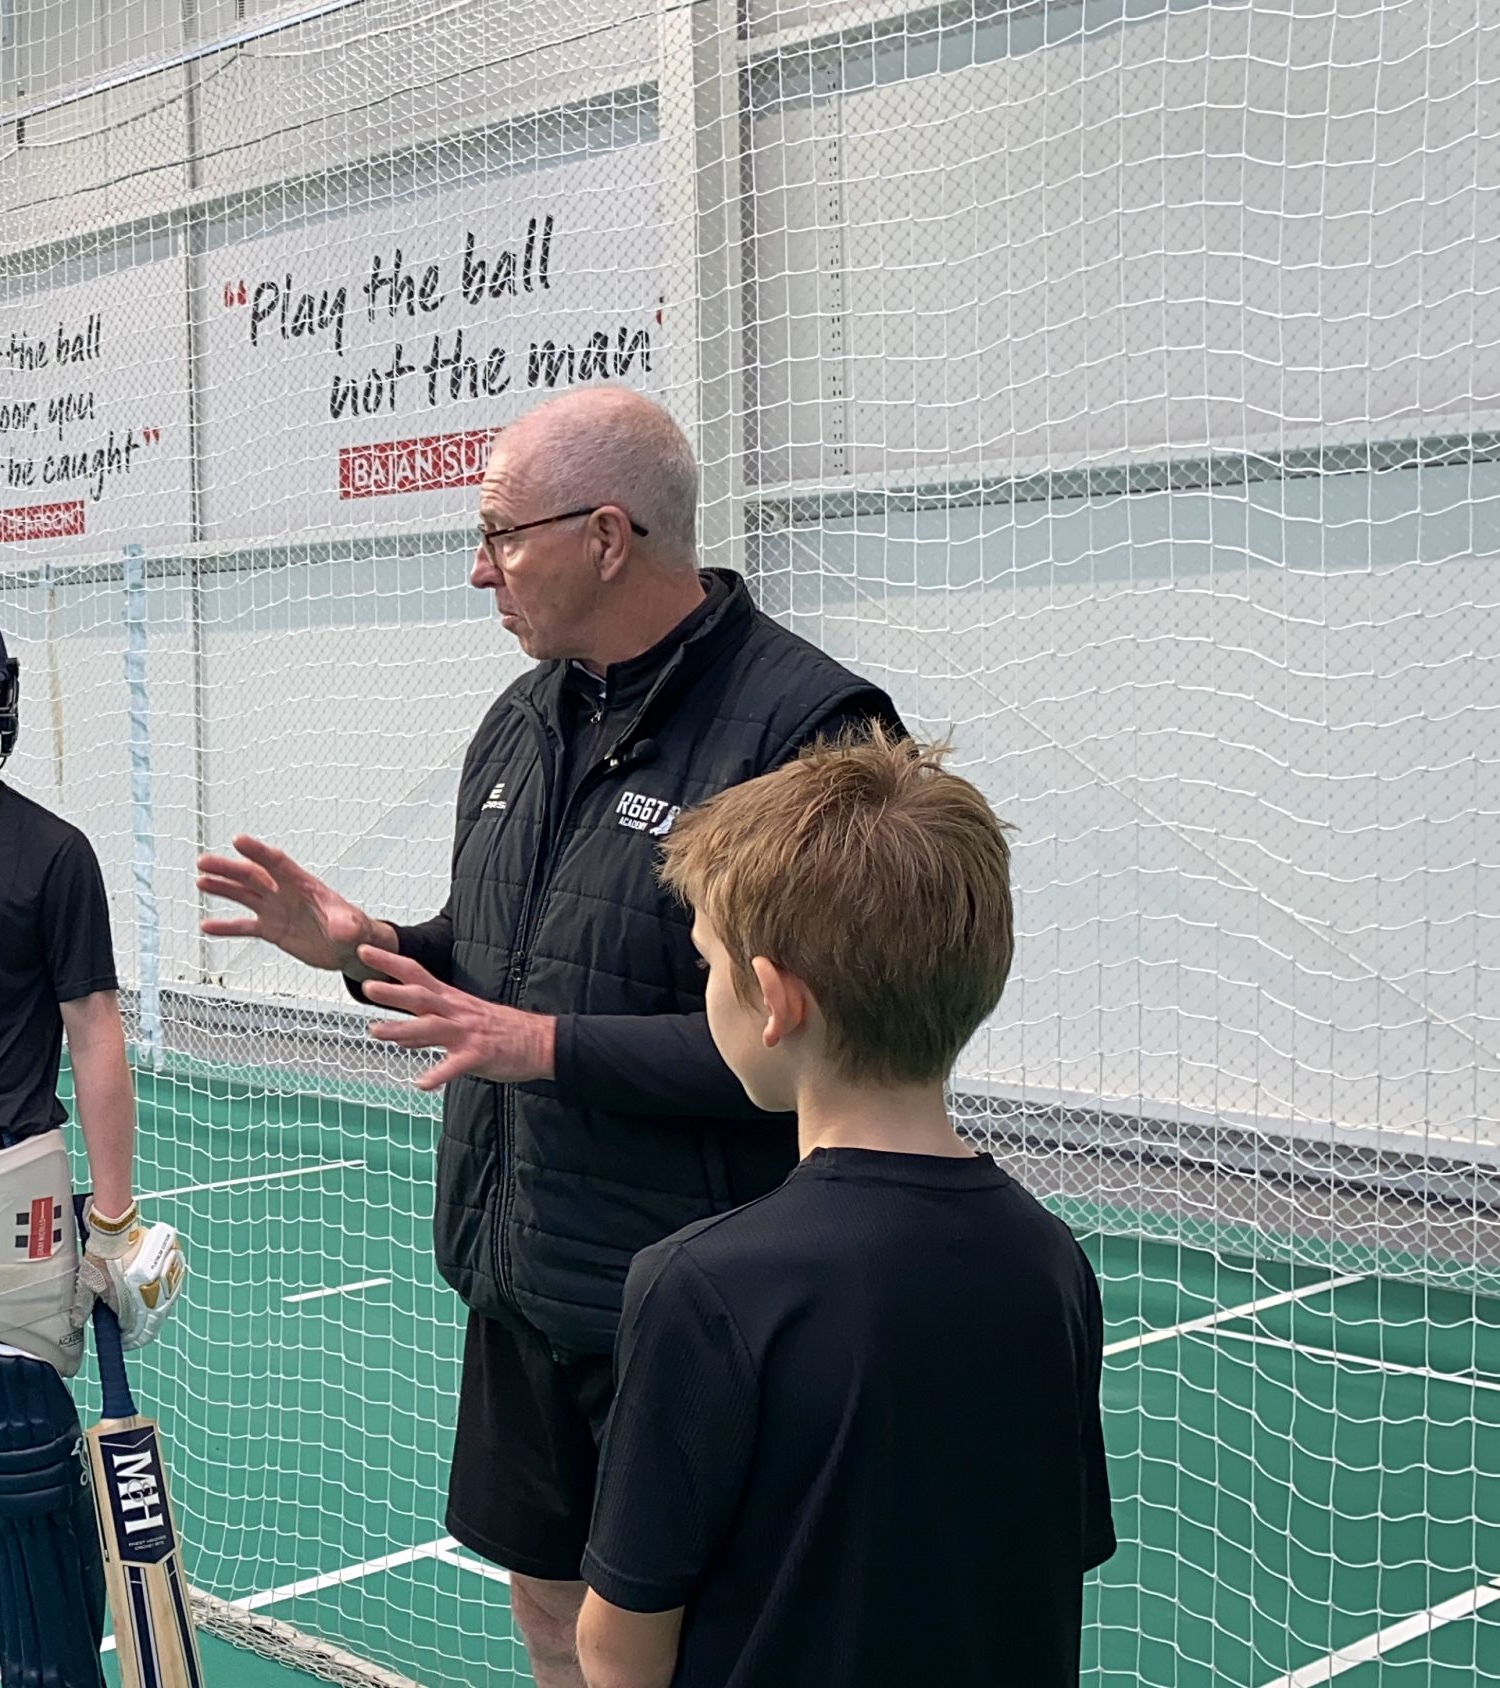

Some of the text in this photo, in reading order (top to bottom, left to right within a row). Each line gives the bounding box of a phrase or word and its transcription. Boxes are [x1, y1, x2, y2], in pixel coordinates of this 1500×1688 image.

[362, 248, 446, 324] the
[461, 214, 554, 304] ball
[7, 331, 49, 376] the
[55, 313, 101, 367] ball
[330, 343, 416, 419] not
[423, 329, 512, 406] the
[48, 392, 96, 442] you
[8, 448, 34, 489] be
[618, 816, 649, 831] ACADEMY
